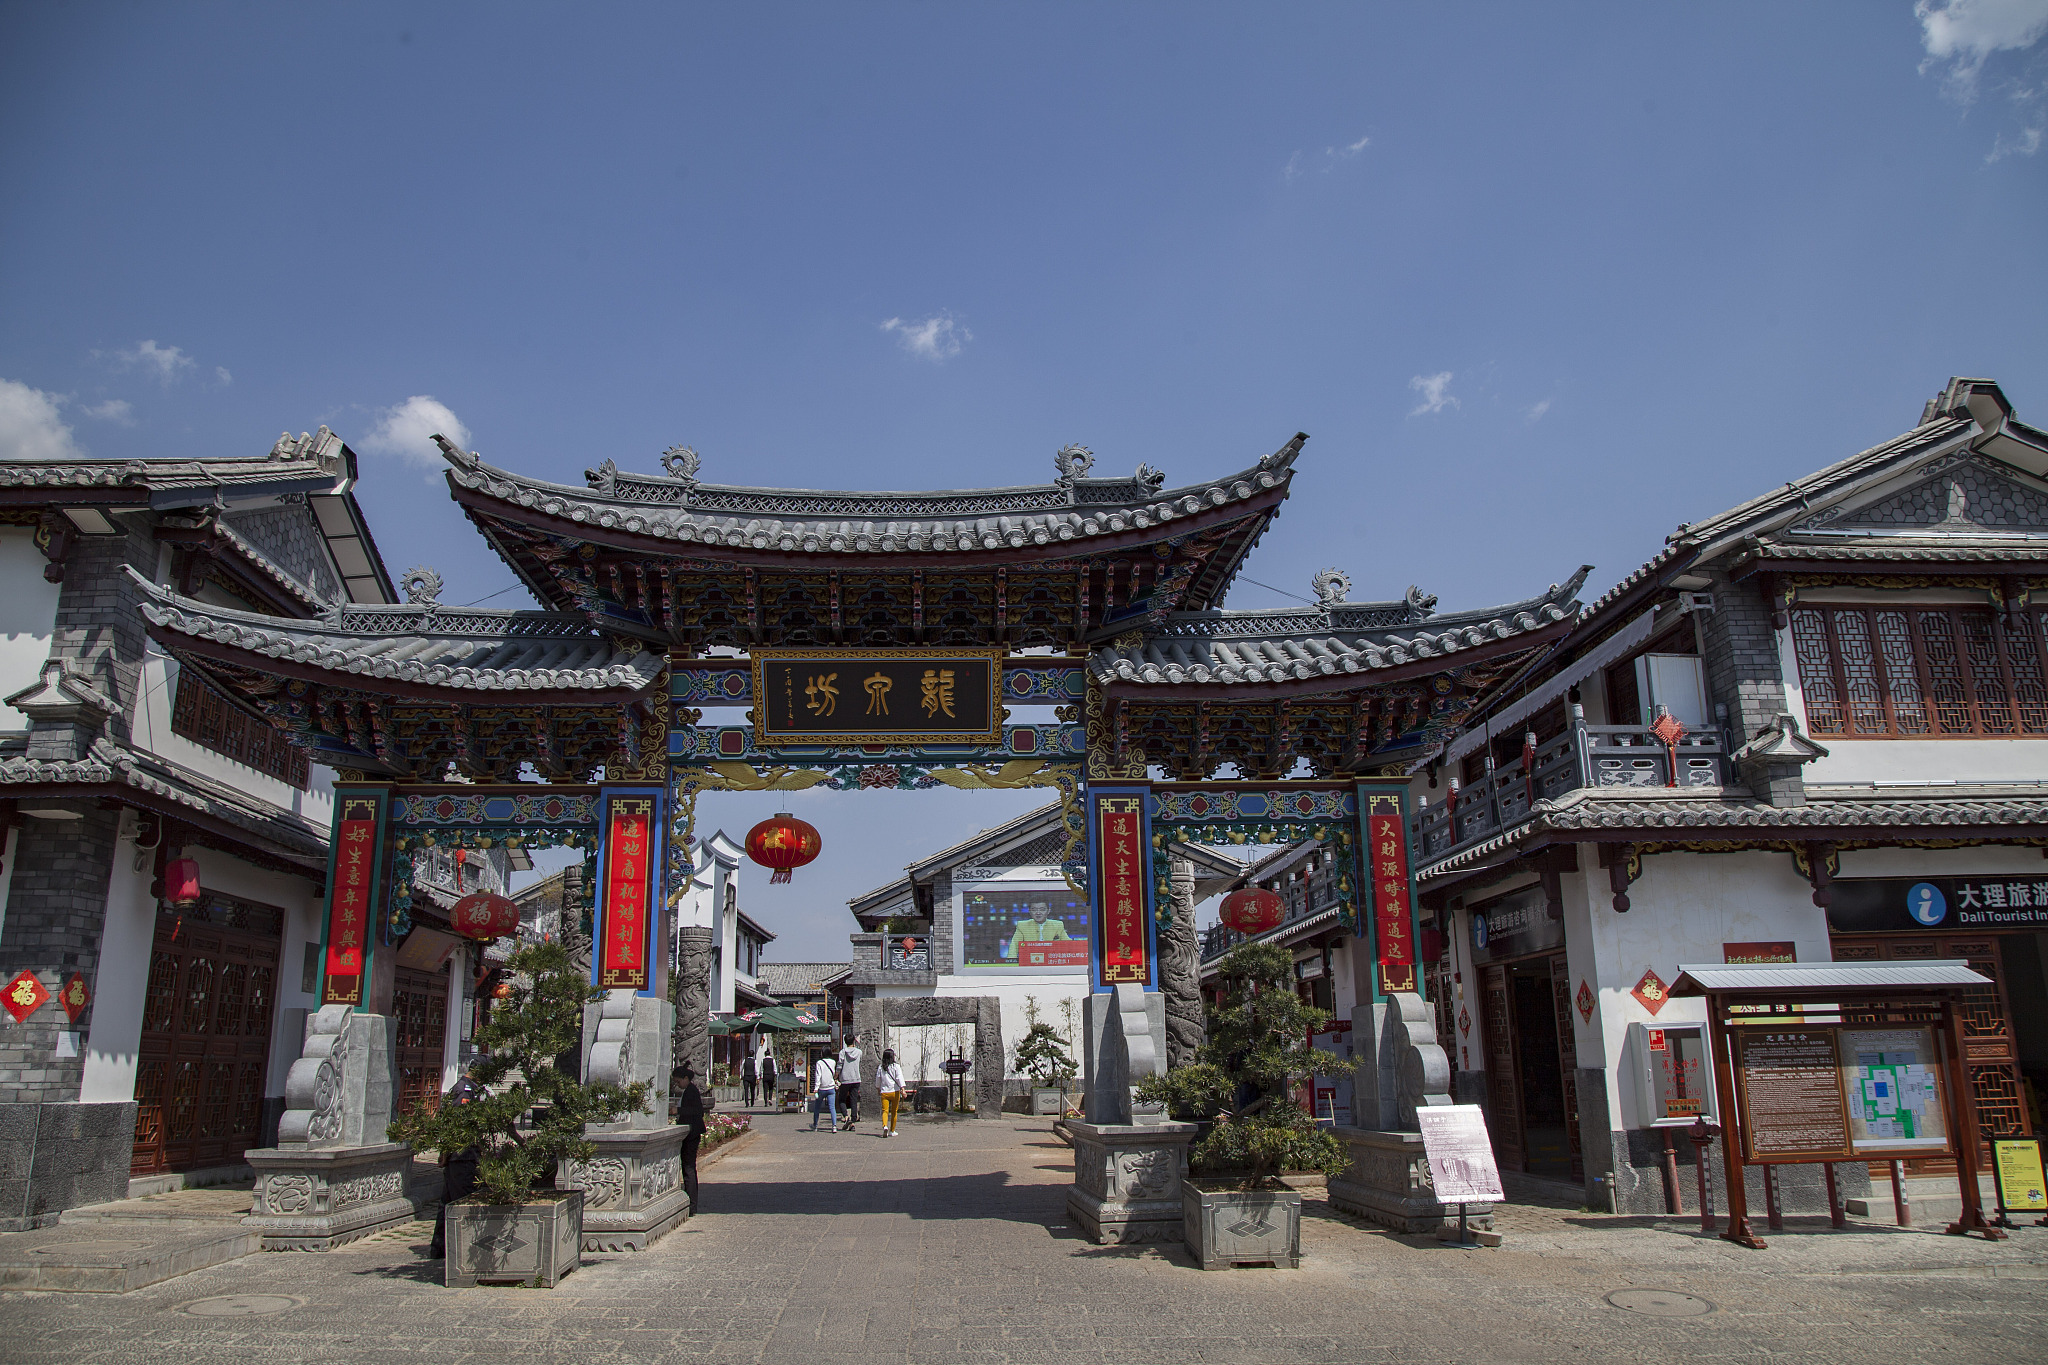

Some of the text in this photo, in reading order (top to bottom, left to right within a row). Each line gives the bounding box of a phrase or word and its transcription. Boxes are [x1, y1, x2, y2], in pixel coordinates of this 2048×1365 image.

[1957, 882, 2048, 909] 大理旅游
[1488, 904, 1548, 932] 大理旅游咨询服务中
[1960, 909, 2048, 923] Dali Tourist In
[11, 979, 37, 1006] 福
[68, 980, 85, 1006] 福
[1641, 978, 1663, 1001] 福
